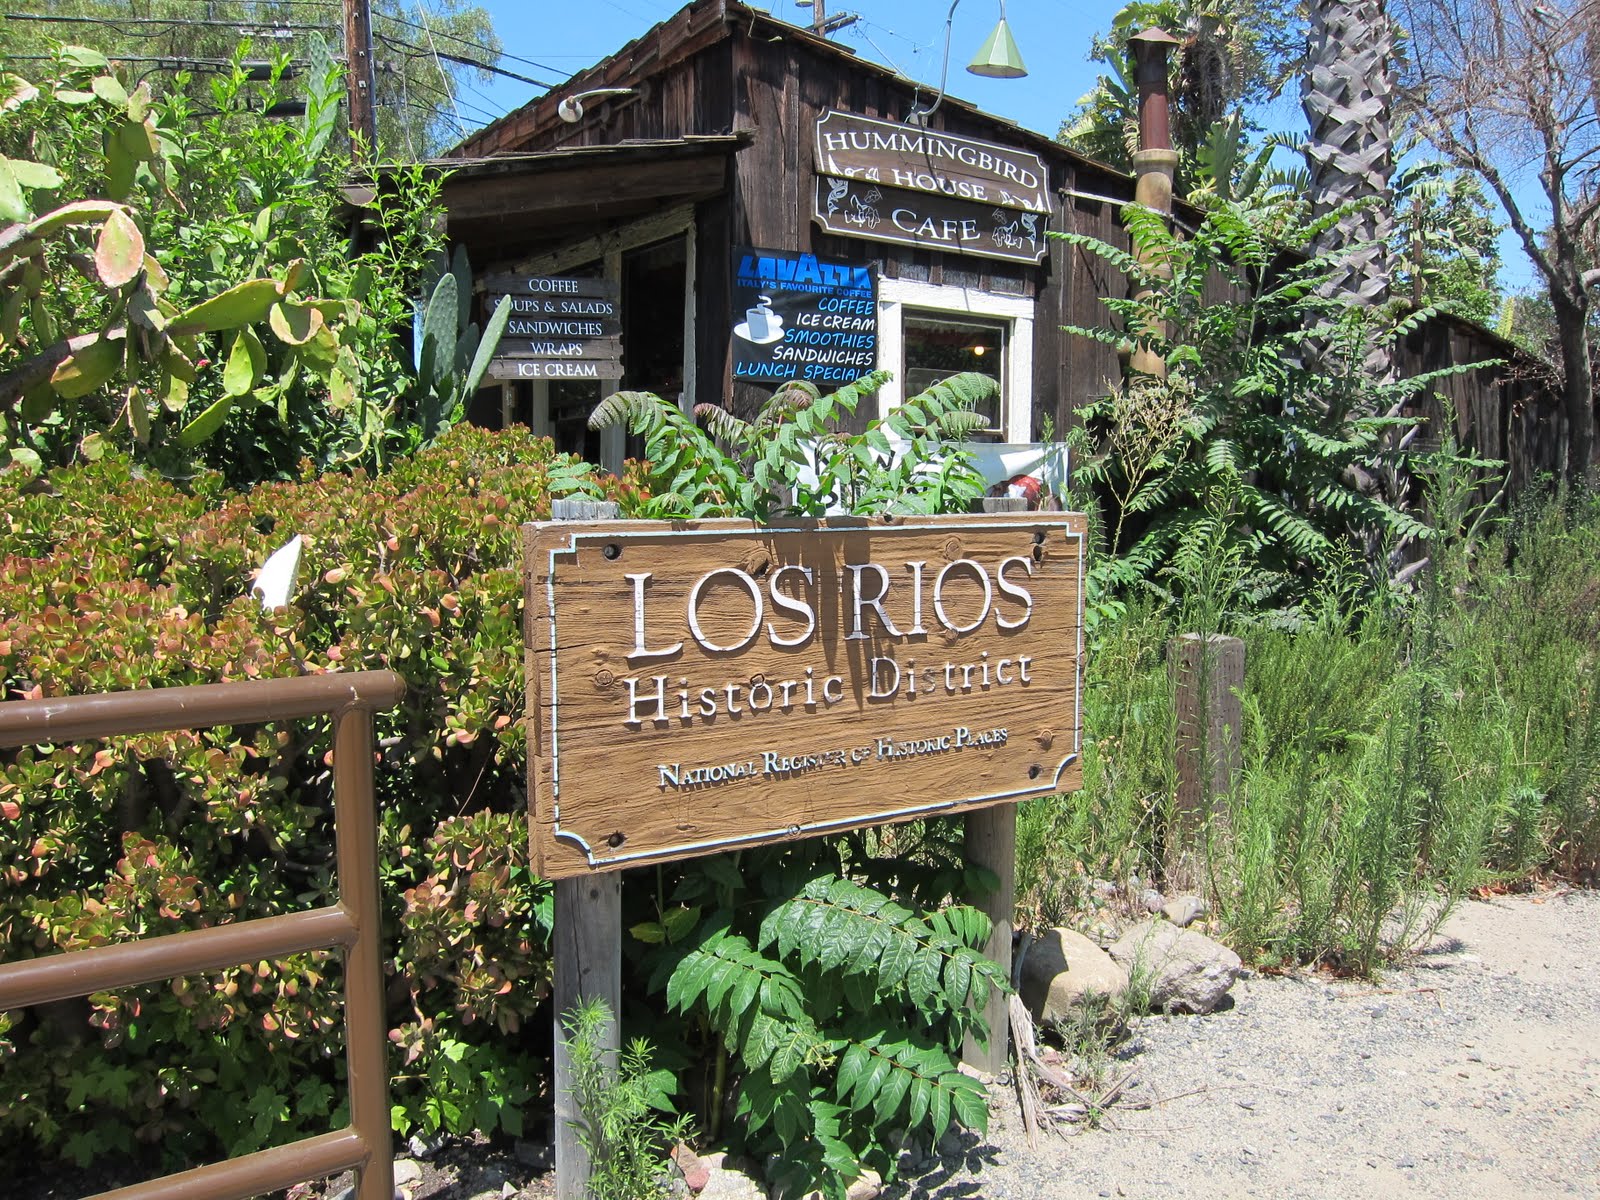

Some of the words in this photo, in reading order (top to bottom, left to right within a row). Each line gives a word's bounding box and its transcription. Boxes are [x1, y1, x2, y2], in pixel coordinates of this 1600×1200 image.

[823, 131, 1038, 189] HUMMINGBIRD
[891, 168, 988, 202] HOUSE
[891, 208, 981, 241] CAFE
[737, 253, 872, 290] LAVAZZA
[528, 279, 579, 293] COFFEE
[737, 279, 777, 290] ITALY'S
[780, 282, 834, 295] FAVOURITE
[837, 288, 872, 299] COFFEE
[544, 301, 557, 313] &
[561, 302, 613, 315] SALADS
[818, 297, 875, 315] COFFEE
[508, 321, 603, 336] SANDWICHES
[796, 312, 821, 326] ICE
[823, 315, 875, 331] CREAM
[784, 328, 875, 349] SMOOTHIES
[530, 342, 583, 356] WRAPS
[772, 345, 874, 366] SANDWICHES
[517, 363, 541, 377] ICE
[545, 363, 598, 377] CREAM
[736, 361, 796, 378] LUNCH
[624, 564, 815, 659] LOS
[845, 555, 1033, 641] RIOS
[623, 667, 844, 724] Historic
[866, 651, 1032, 699] District
[658, 762, 758, 788] NATIONAL
